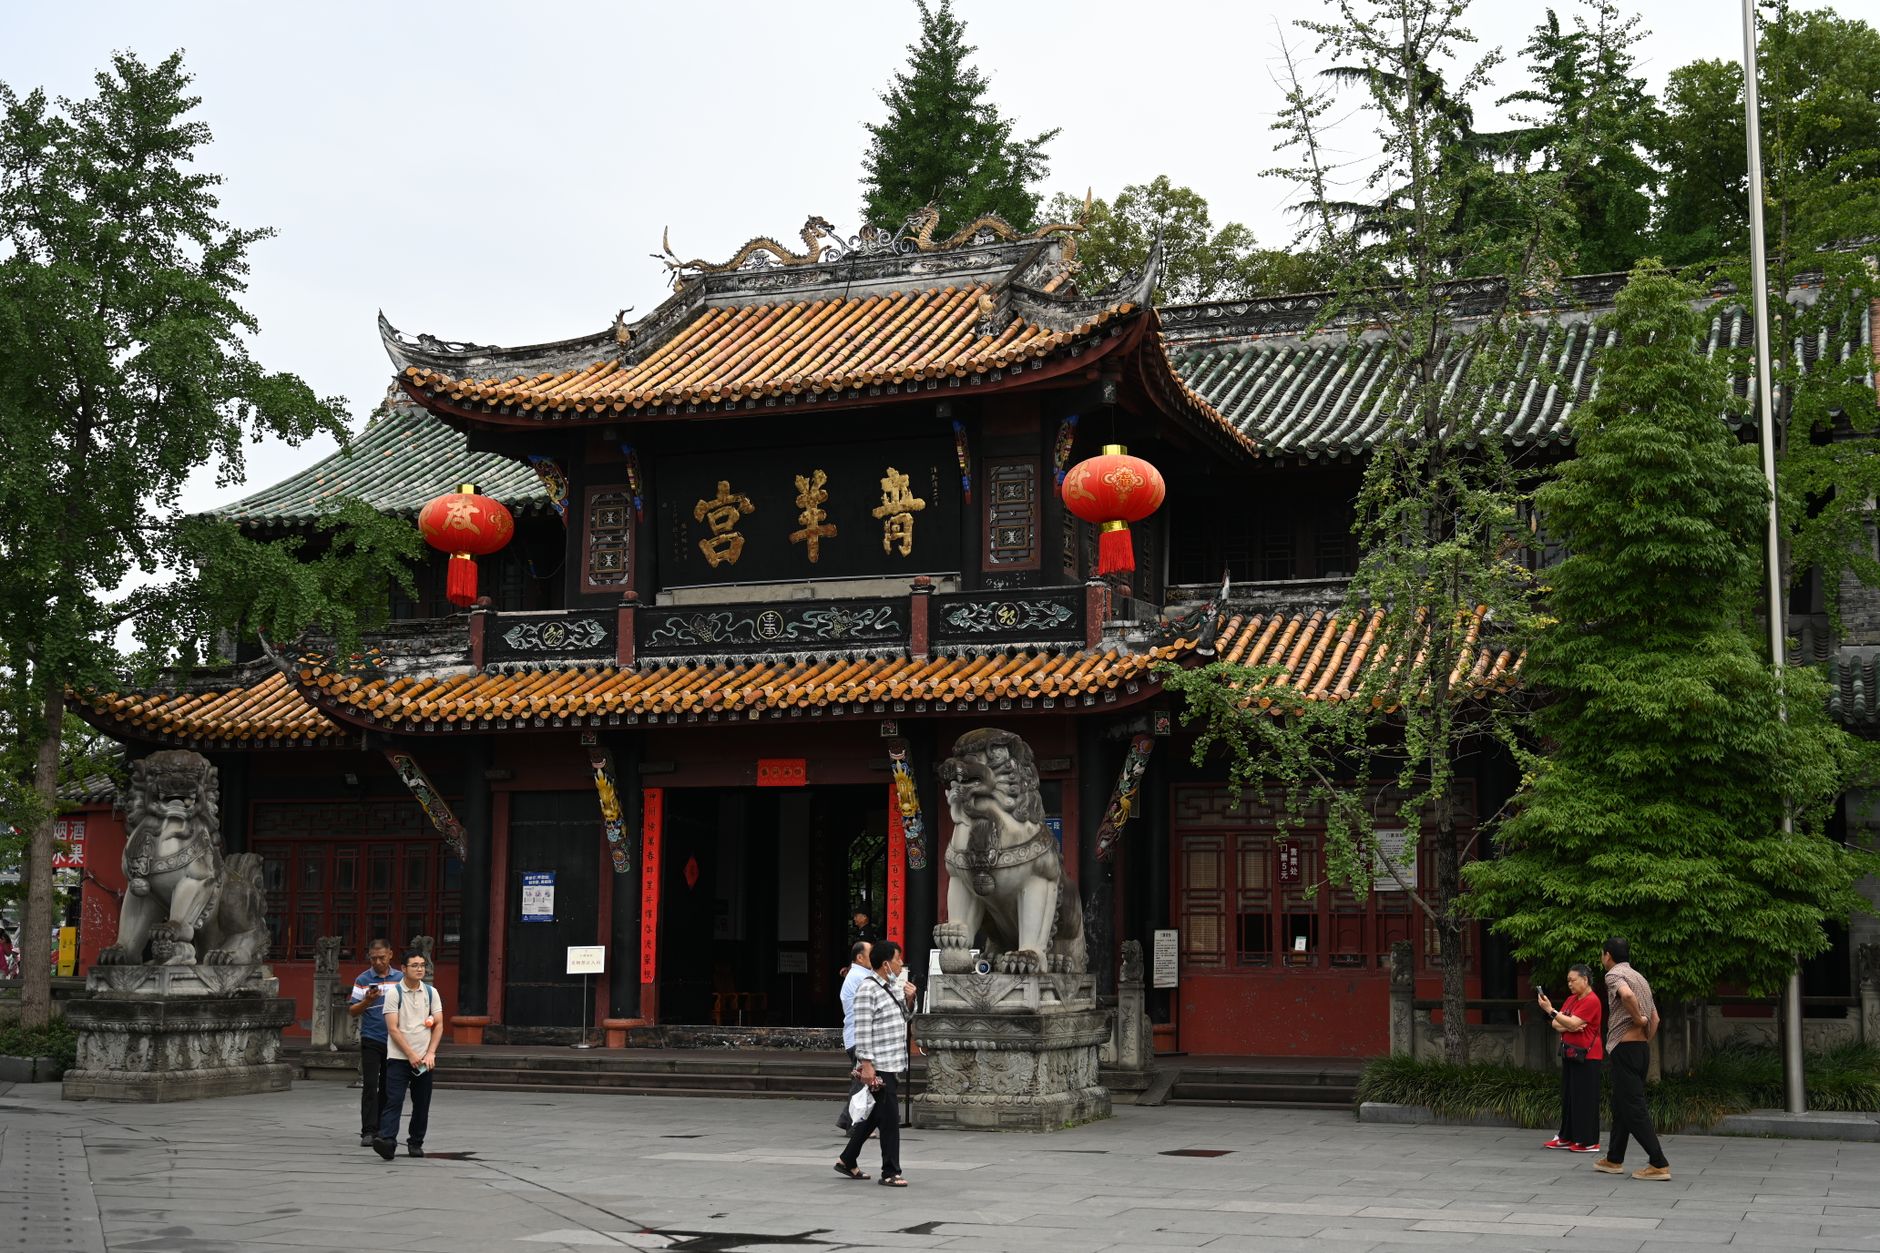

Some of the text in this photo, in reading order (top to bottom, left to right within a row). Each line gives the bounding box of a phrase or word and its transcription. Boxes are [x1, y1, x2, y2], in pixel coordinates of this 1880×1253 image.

[52, 820, 86, 841] 烟酒
[52, 843, 85, 865] 水果
[1280, 843, 1289, 880] 门票5元
[1290, 847, 1298, 876] 售票处
